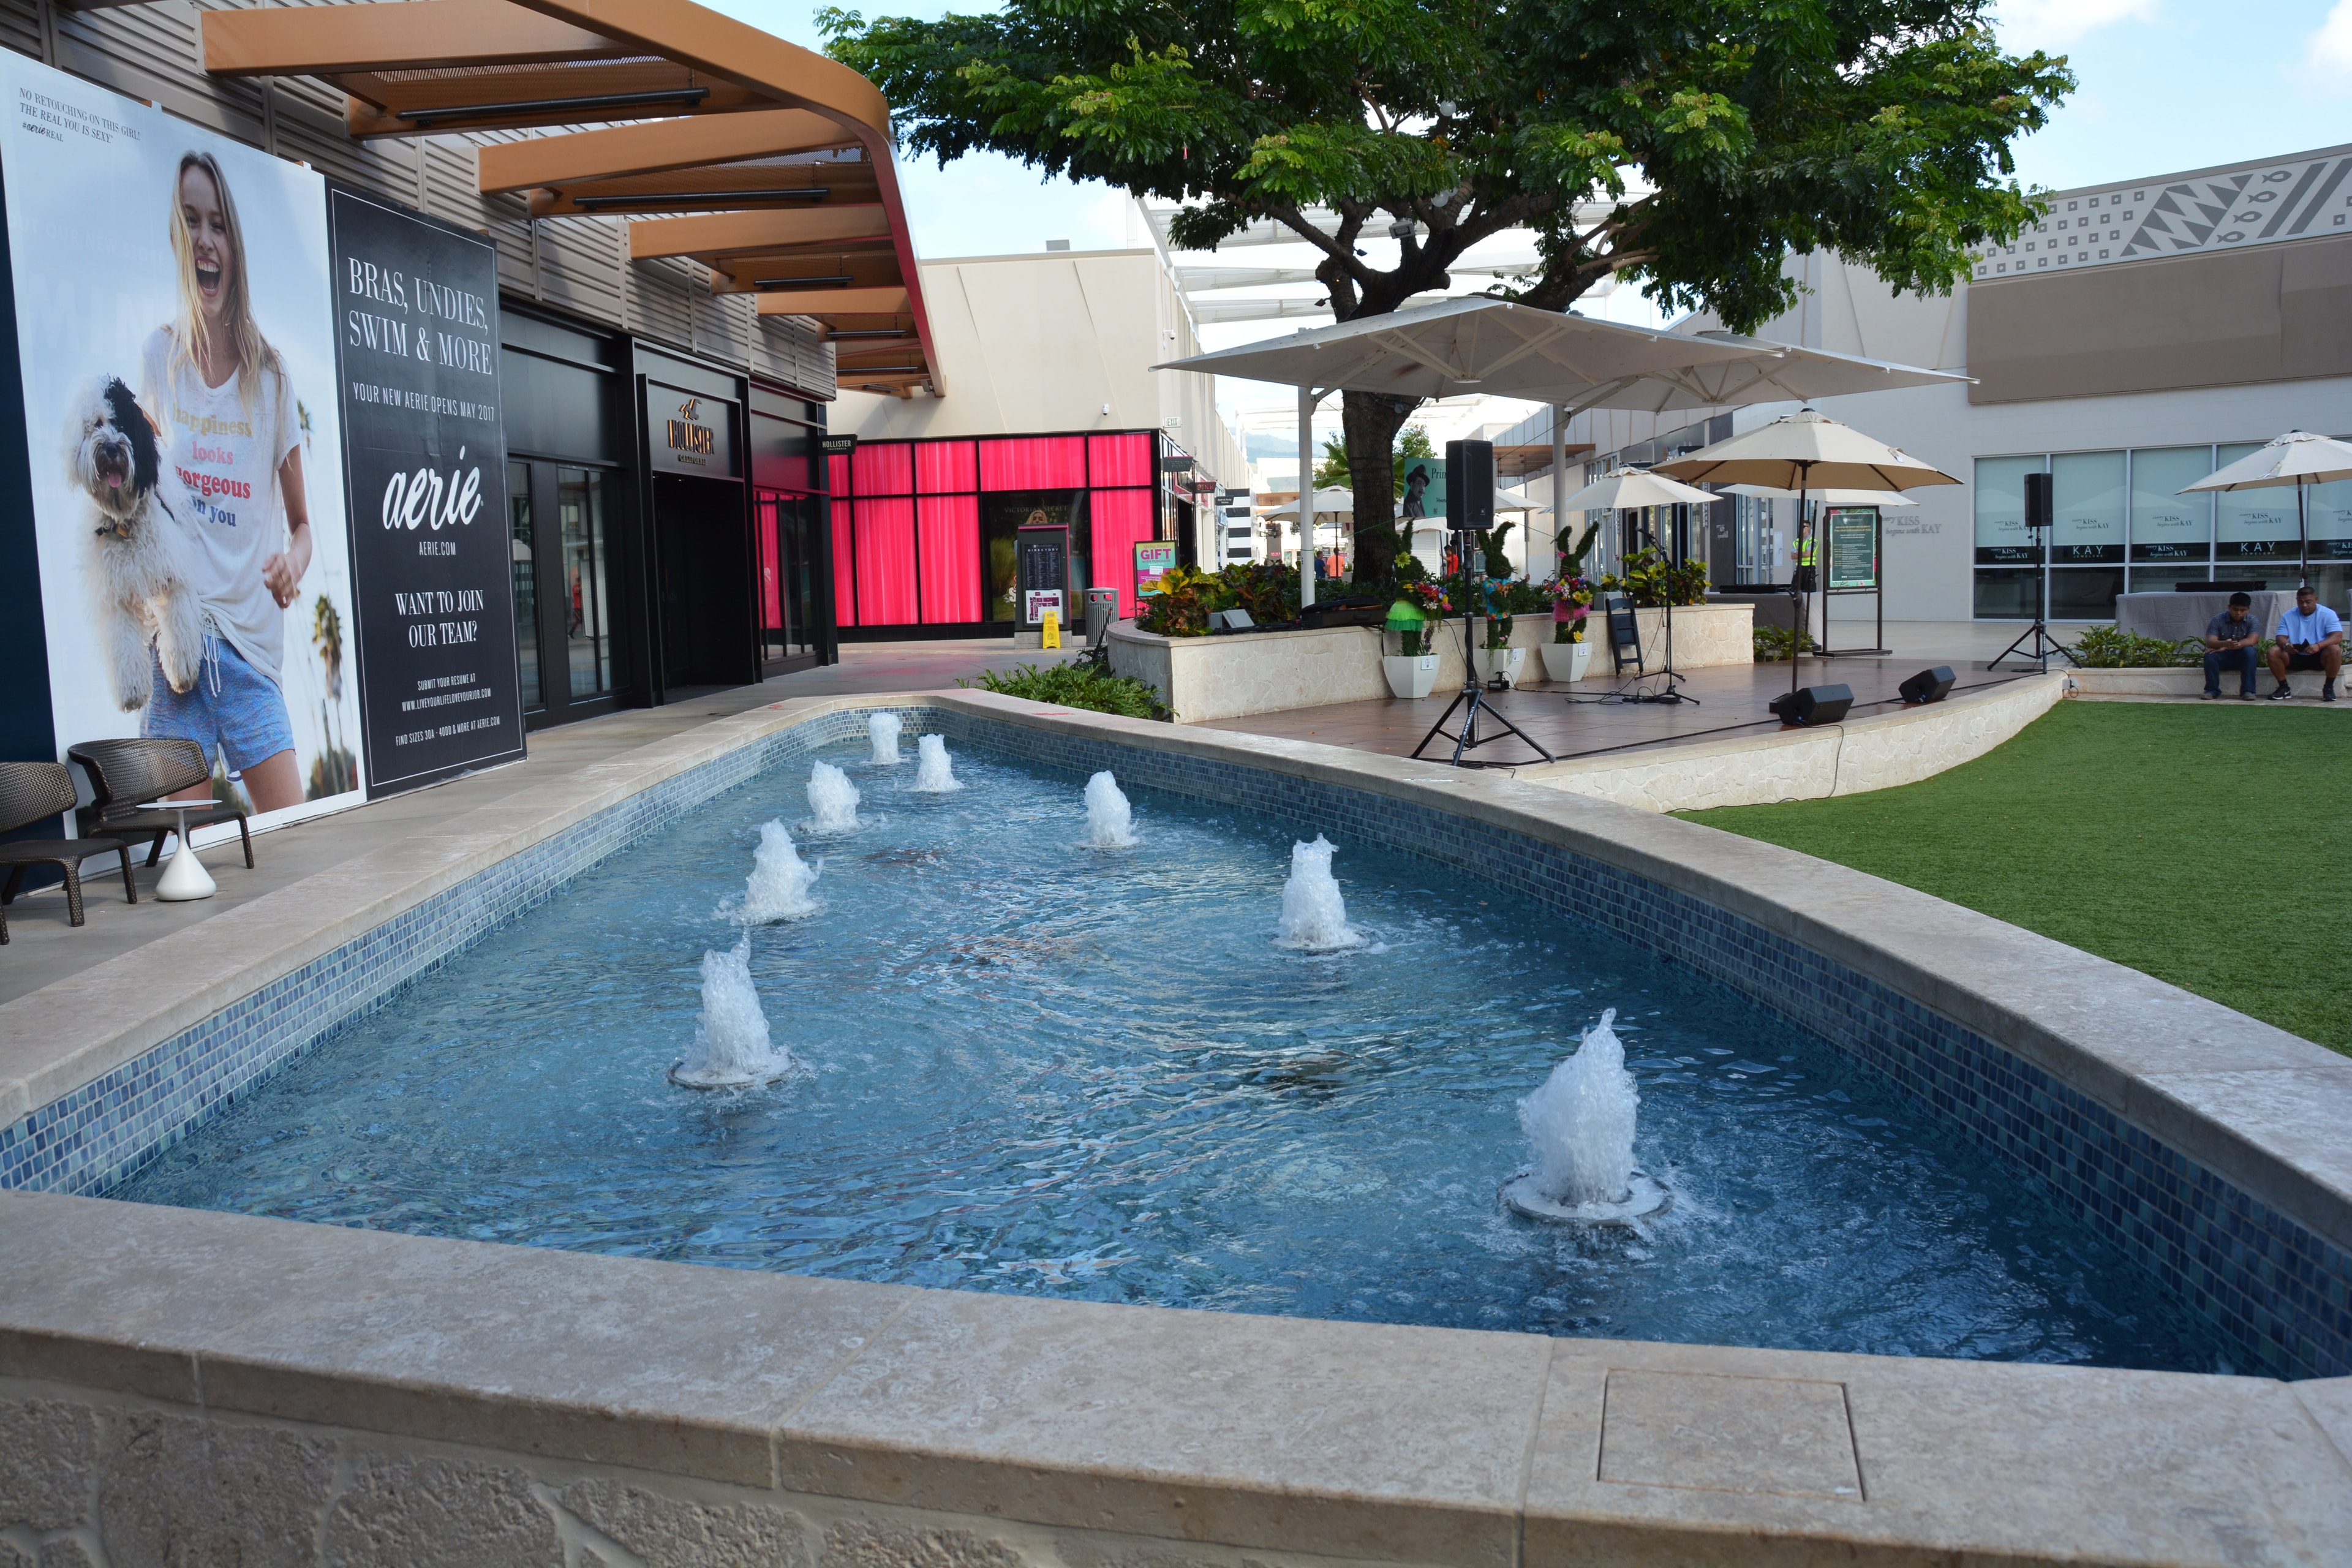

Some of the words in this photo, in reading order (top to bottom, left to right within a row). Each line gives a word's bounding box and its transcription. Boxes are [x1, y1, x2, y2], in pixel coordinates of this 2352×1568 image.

[20, 88, 32, 100] NO
[35, 93, 88, 121] RETOUCHING
[89, 114, 100, 125] ON
[102, 118, 119, 132] THIS
[121, 126, 140, 141] GIRL!
[20, 102, 37, 118] THE
[40, 110, 62, 126] REAL
[64, 118, 80, 132] YOU
[82, 125, 89, 135] IS
[348, 257, 408, 315] BRAS,
[414, 277, 488, 336] UNDIES,
[349, 310, 409, 356] SWIM
[416, 327, 431, 362] &
[437, 332, 492, 375] MORE
[353, 382, 380, 404] YOUR
[383, 387, 401, 407] NEW
[405, 391, 429, 411] AERIE
[431, 396, 458, 416] OPENS
[461, 401, 475, 419] MAY
[478, 404, 494, 422] 2017
[172, 402, 252, 437] happiness
[1167, 418, 1177, 426] EXIT
[668, 420, 714, 454] HOLLISTER
[192, 440, 233, 465] looks
[209, 506, 236, 527] you
[1897, 516, 1920, 526] KISS
[1921, 523, 1942, 533] KAY
[419, 541, 456, 556] AERIE.COM
[1140, 548, 1171, 560] GIFT
[2073, 545, 2103, 555] KAY
[2241, 542, 2275, 551] KAY
[395, 592, 434, 616] WANT
[437, 591, 453, 613] TO
[458, 590, 484, 612] JOIN
[409, 624, 437, 648] OUR
[440, 620, 477, 644] TEAM?
[417, 679, 436, 691] SUBMIT
[437, 677, 450, 687] YOUR
[451, 674, 469, 686] RESUME
[470, 673, 476, 683] AT
[401, 687, 491, 712] WWW.LIVEYOURLIFELOVEYOURJOB.COM
[396, 734, 408, 746] FIND
[409, 731, 424, 743] SIZES
[424, 729, 435, 740] 30A
[439, 725, 452, 737] 40DD
[453, 724, 456, 734] &
[457, 722, 470, 733] MORE
[470, 720, 477, 730] AT
[477, 715, 500, 729] AERIE.COM
